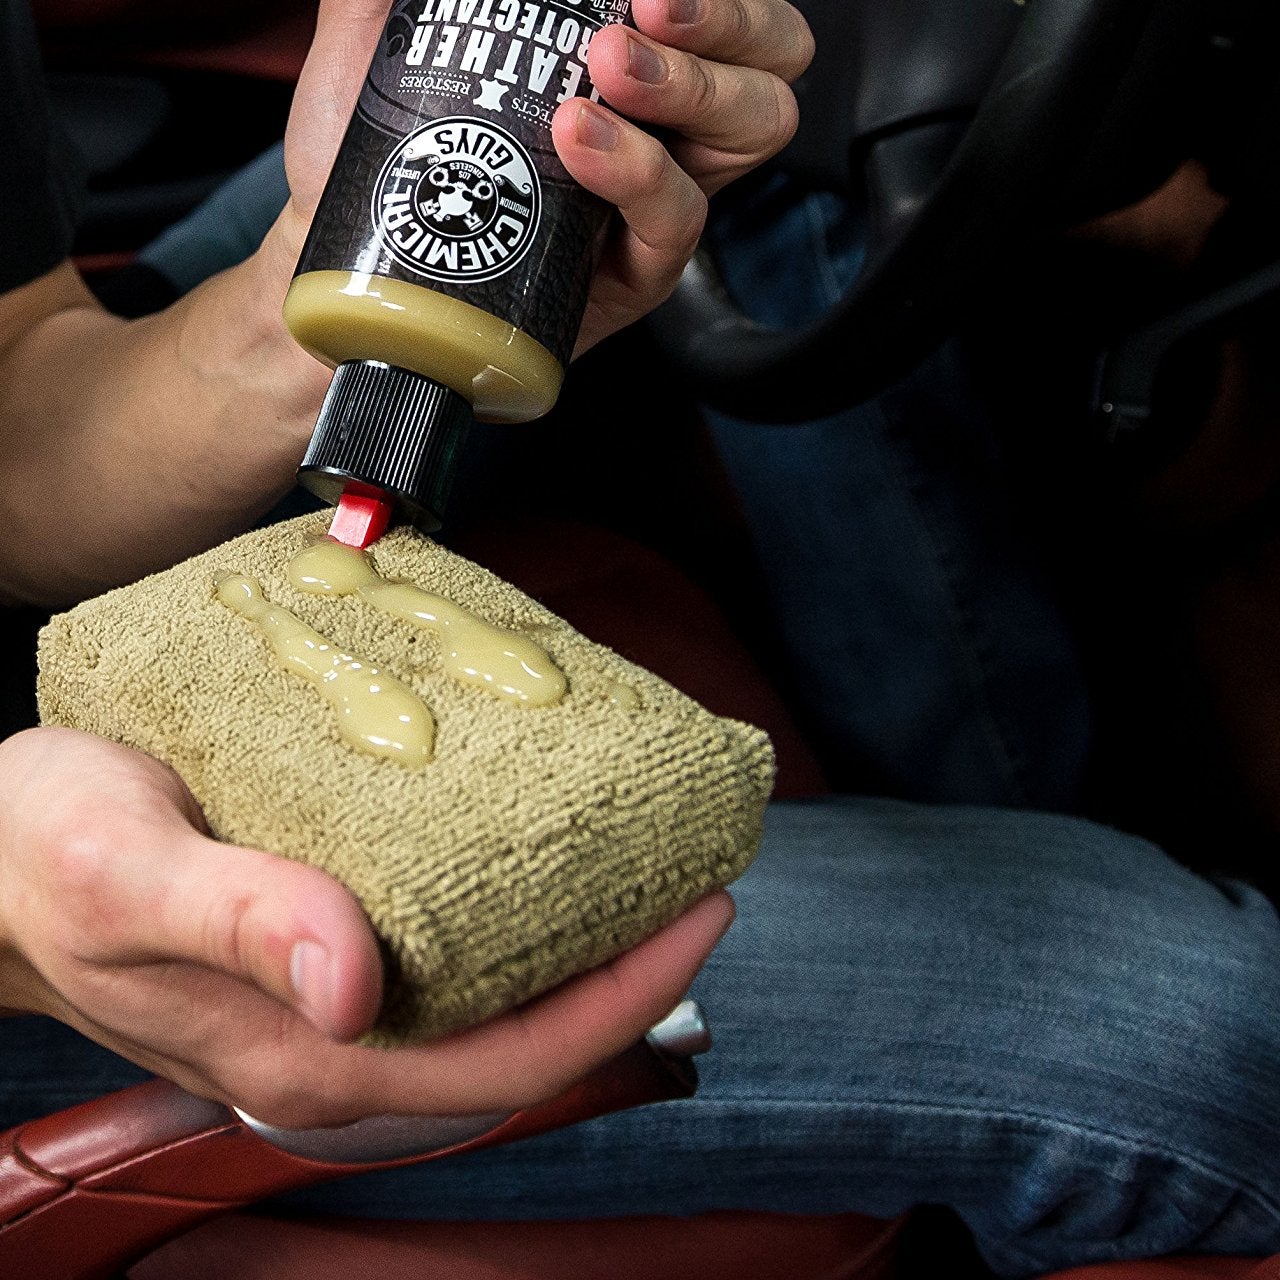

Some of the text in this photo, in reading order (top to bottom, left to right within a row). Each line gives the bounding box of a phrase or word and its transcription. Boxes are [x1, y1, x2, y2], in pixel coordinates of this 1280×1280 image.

[399, 76, 471, 95] RESTORES
[434, 127, 512, 169] GUYS
[390, 167, 420, 179] LIFESTYLE
[449, 162, 484, 178] ANGELES
[457, 170, 470, 179] LOS
[499, 196, 529, 216] TRADITION
[378, 185, 523, 269] CHEMICAL
